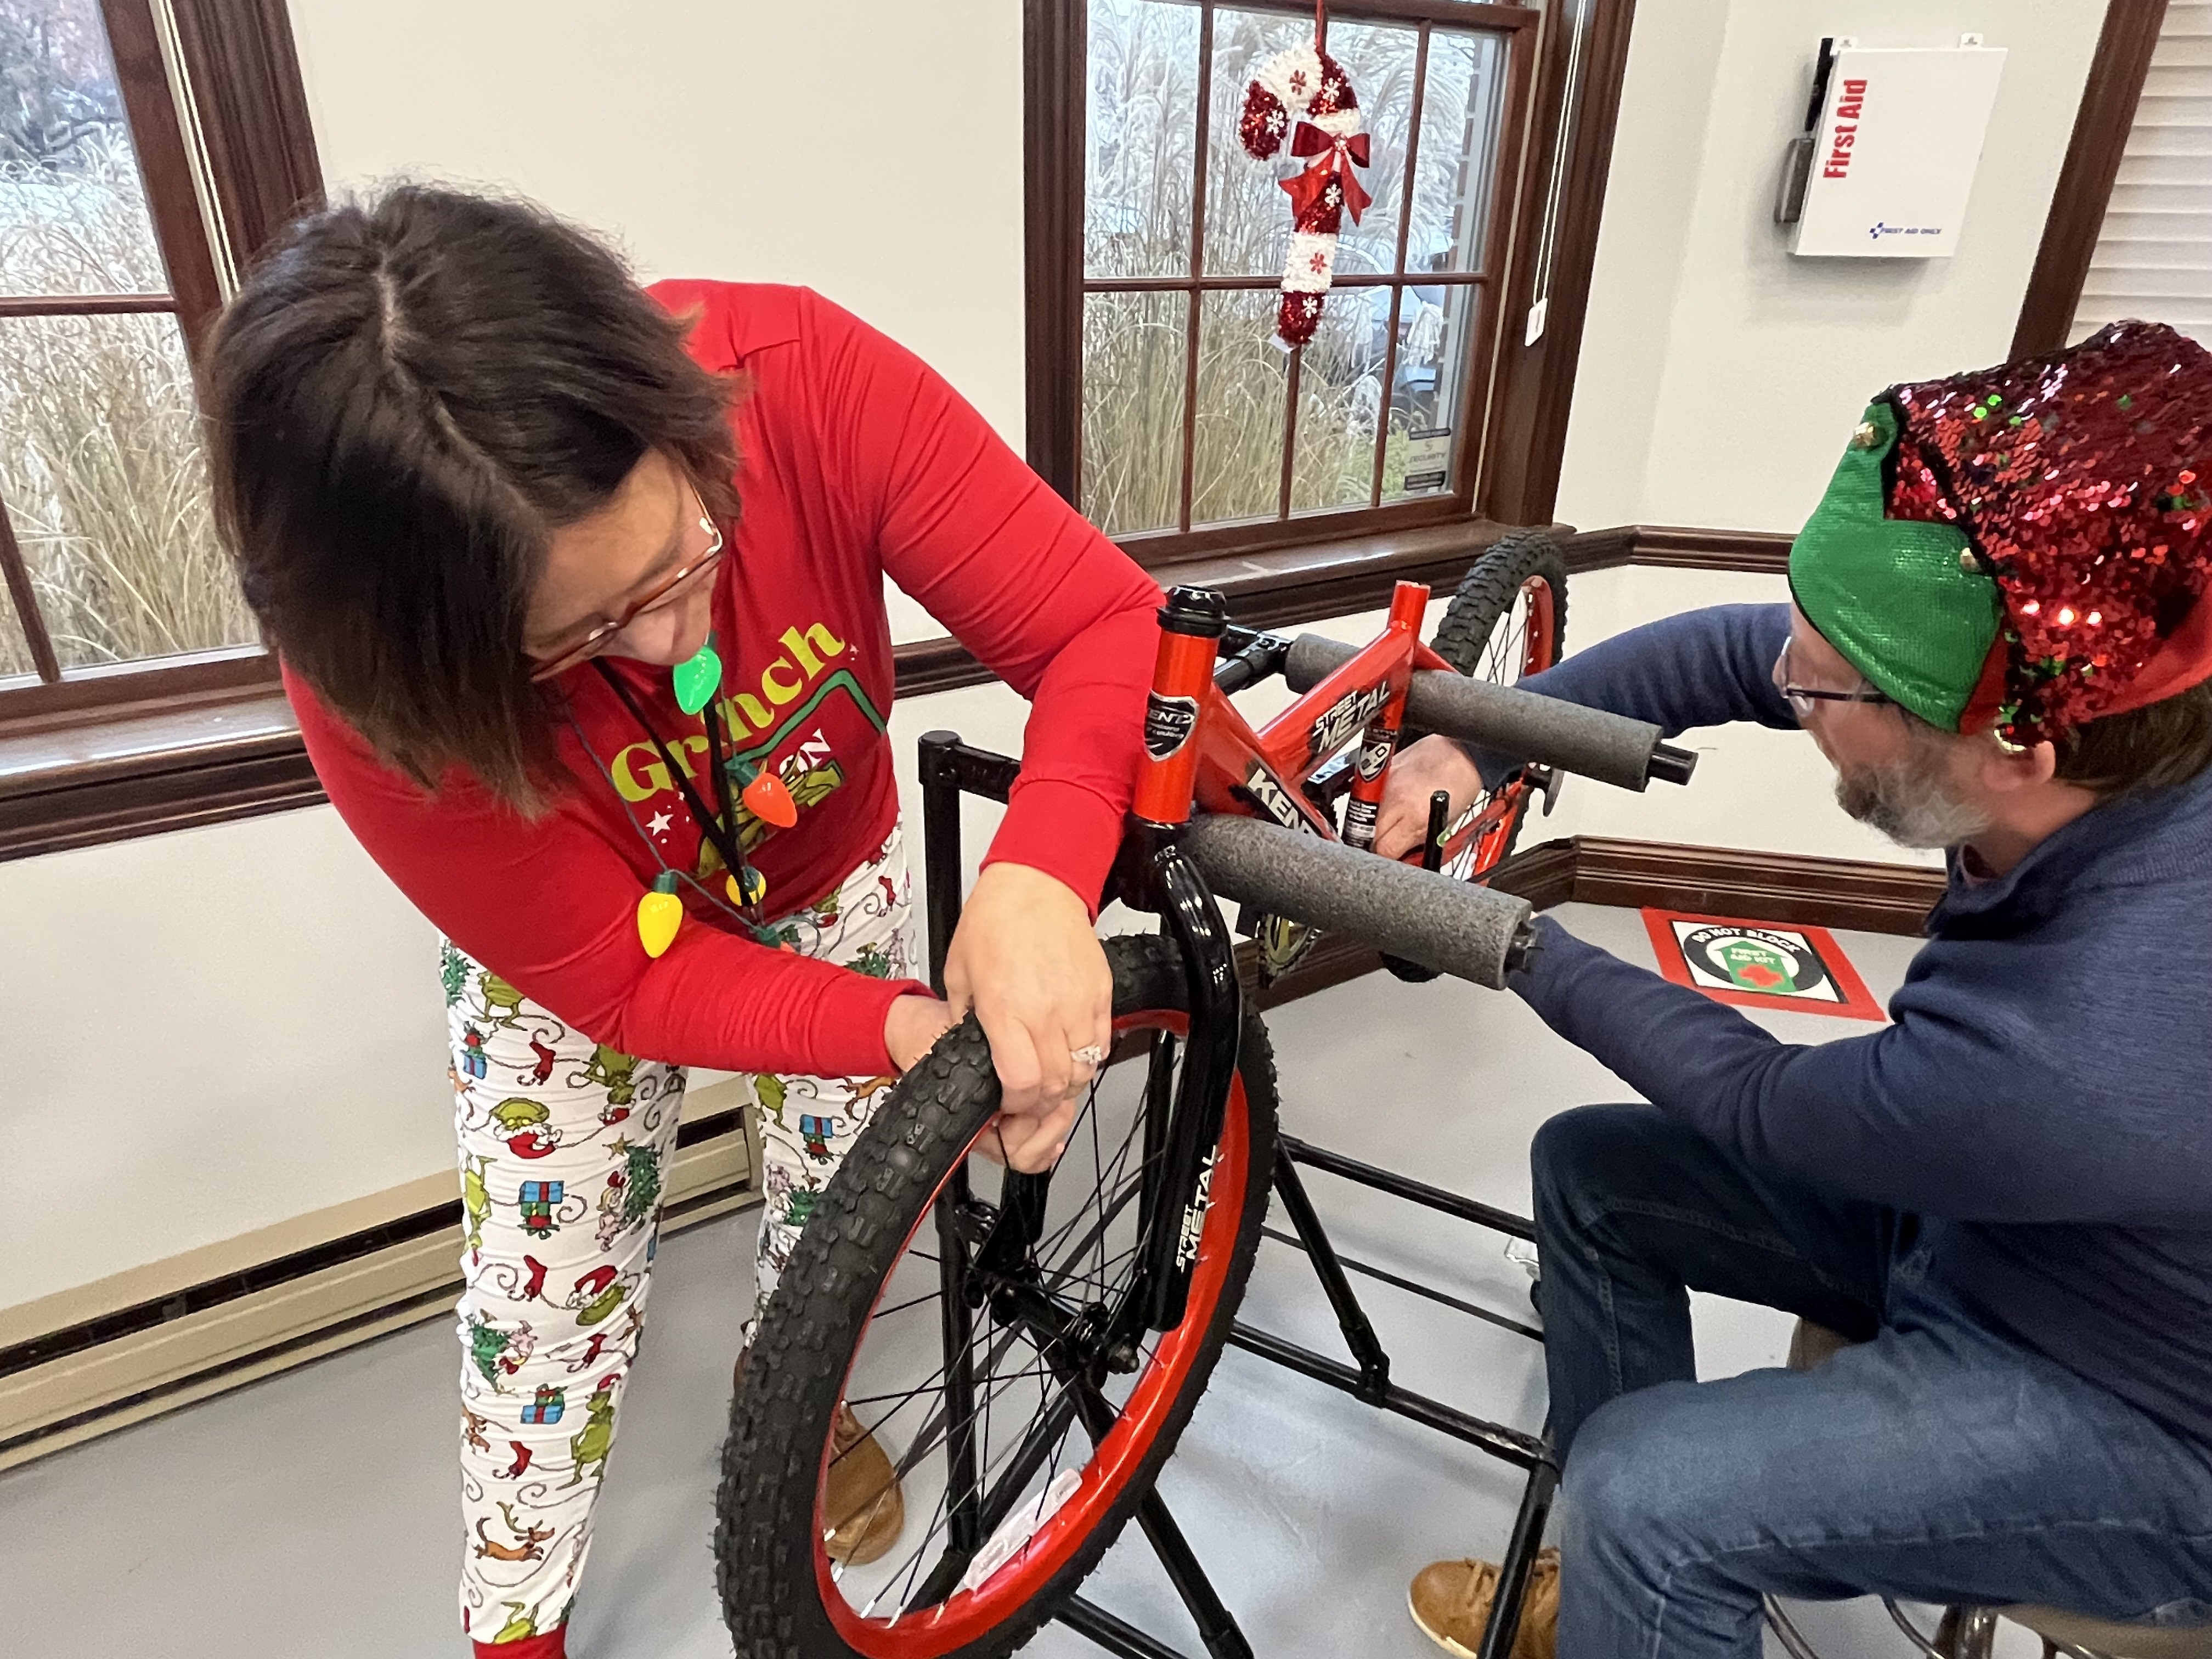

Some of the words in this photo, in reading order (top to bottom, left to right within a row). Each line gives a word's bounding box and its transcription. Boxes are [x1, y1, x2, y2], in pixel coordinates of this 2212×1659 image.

[1837, 79, 1867, 119] Aid
[1823, 125, 1858, 178] First
[611, 622, 845, 802] Grnch
[1312, 690, 1358, 737] STREET
[1318, 681, 1390, 753] METAL
[1691, 931, 1712, 943] DO
[1708, 928, 1740, 937] NOT
[1747, 929, 1801, 952] BLOCK
[1186, 1145, 1217, 1260] METAL
[1176, 1204, 1195, 1274] STREET
